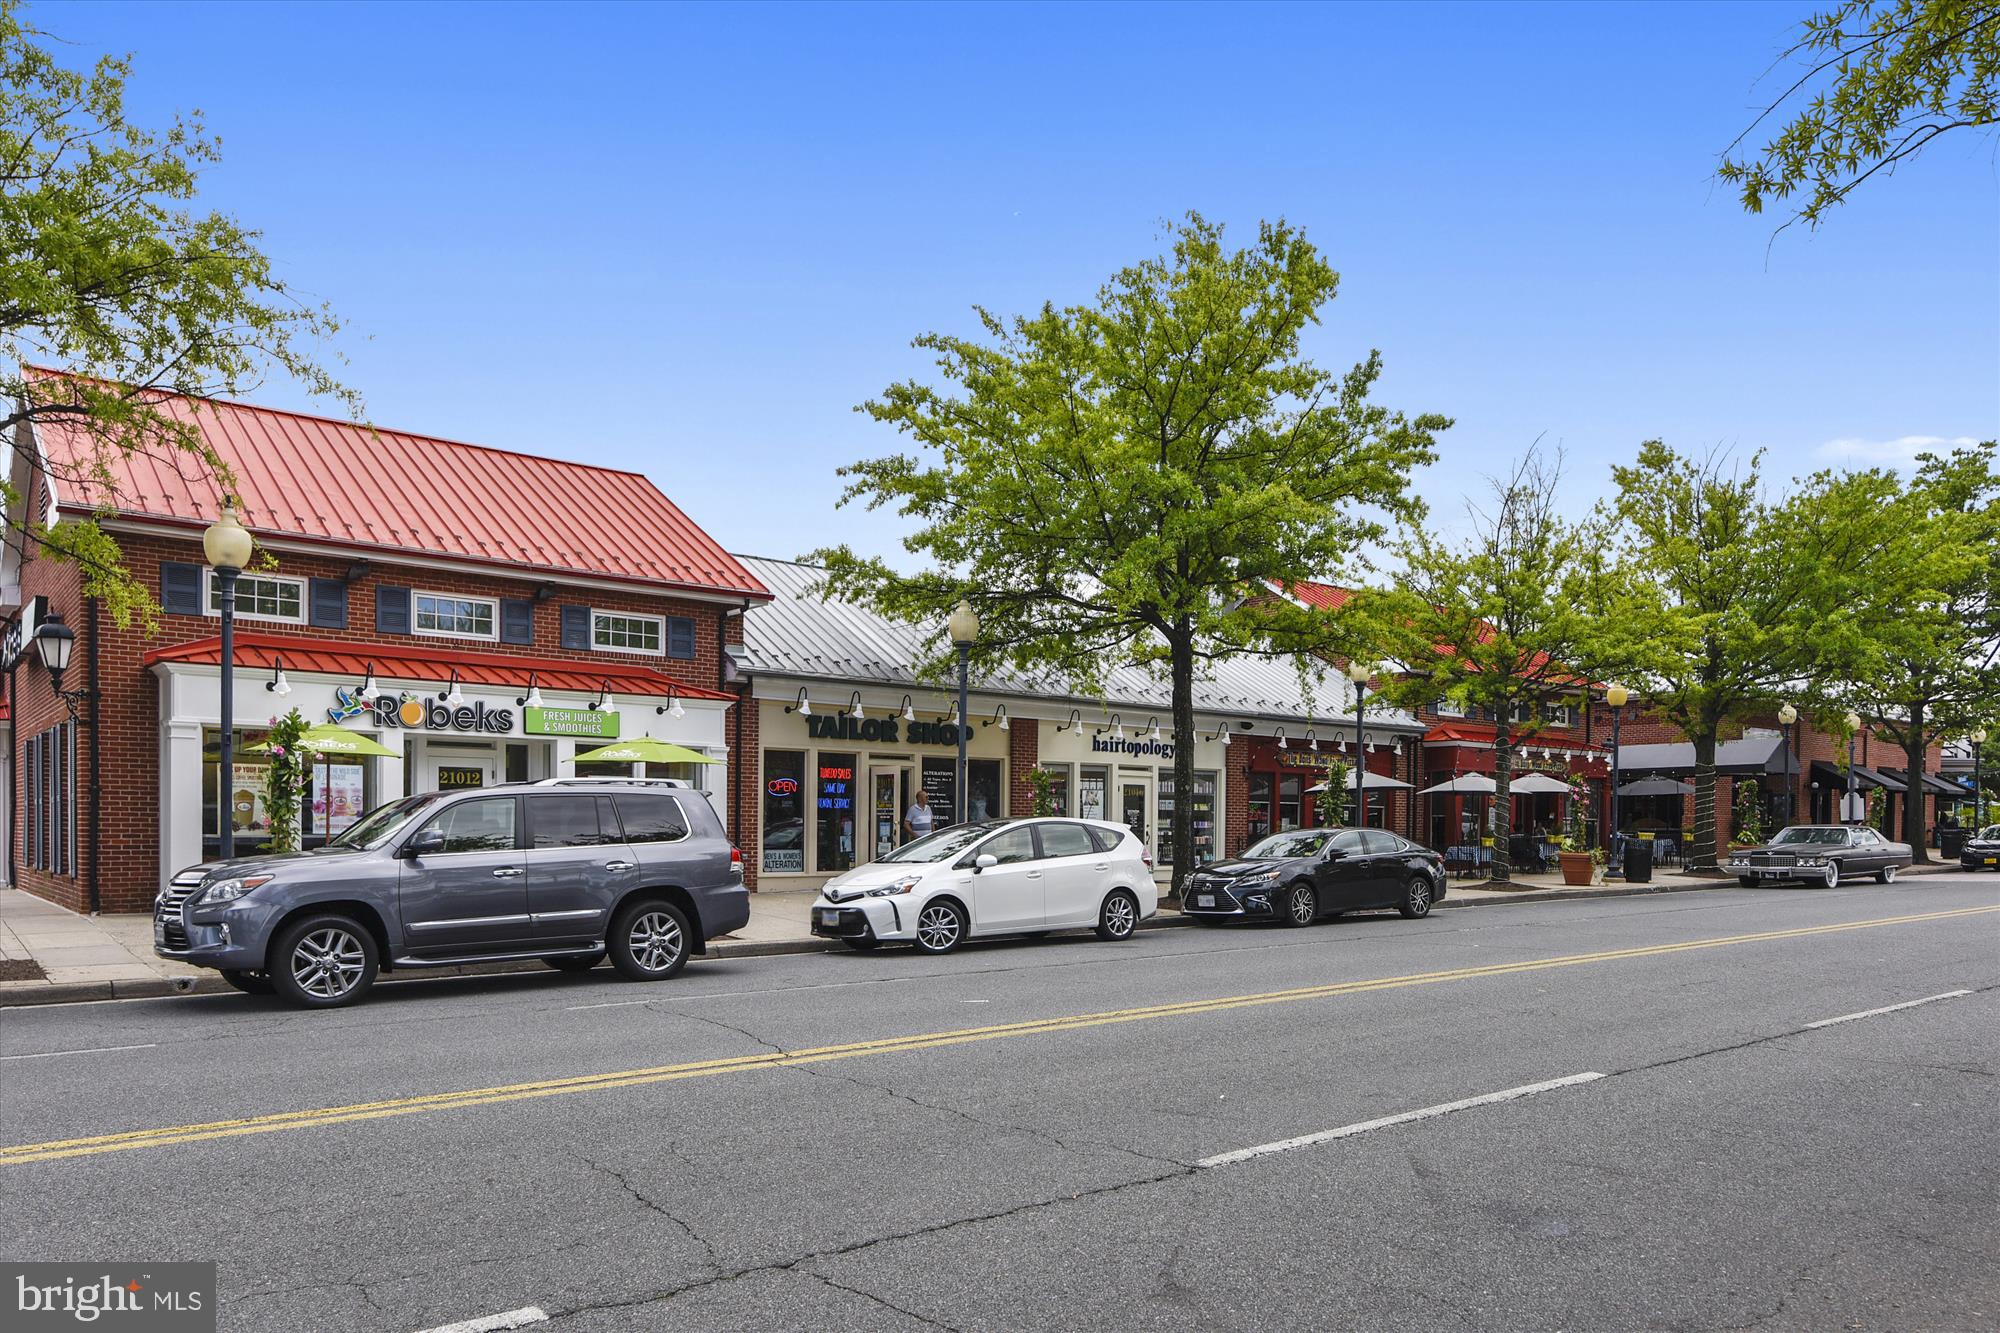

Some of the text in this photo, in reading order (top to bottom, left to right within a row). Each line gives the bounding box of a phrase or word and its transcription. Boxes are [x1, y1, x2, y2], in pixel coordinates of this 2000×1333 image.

[373, 692, 514, 733] Robeks
[543, 711, 602, 723] FRESH JUICES
[543, 722, 602, 734] & SMOOTHIES
[805, 715, 974, 747] TAILOR SHOP
[1092, 735, 1176, 759] hairtopology
[439, 771, 481, 785] 21012
[838, 768, 852, 779] SALES
[768, 780, 797, 793] OPEN
[823, 782, 847, 794] SAME DAY
[764, 860, 802, 869] ALTERATION
